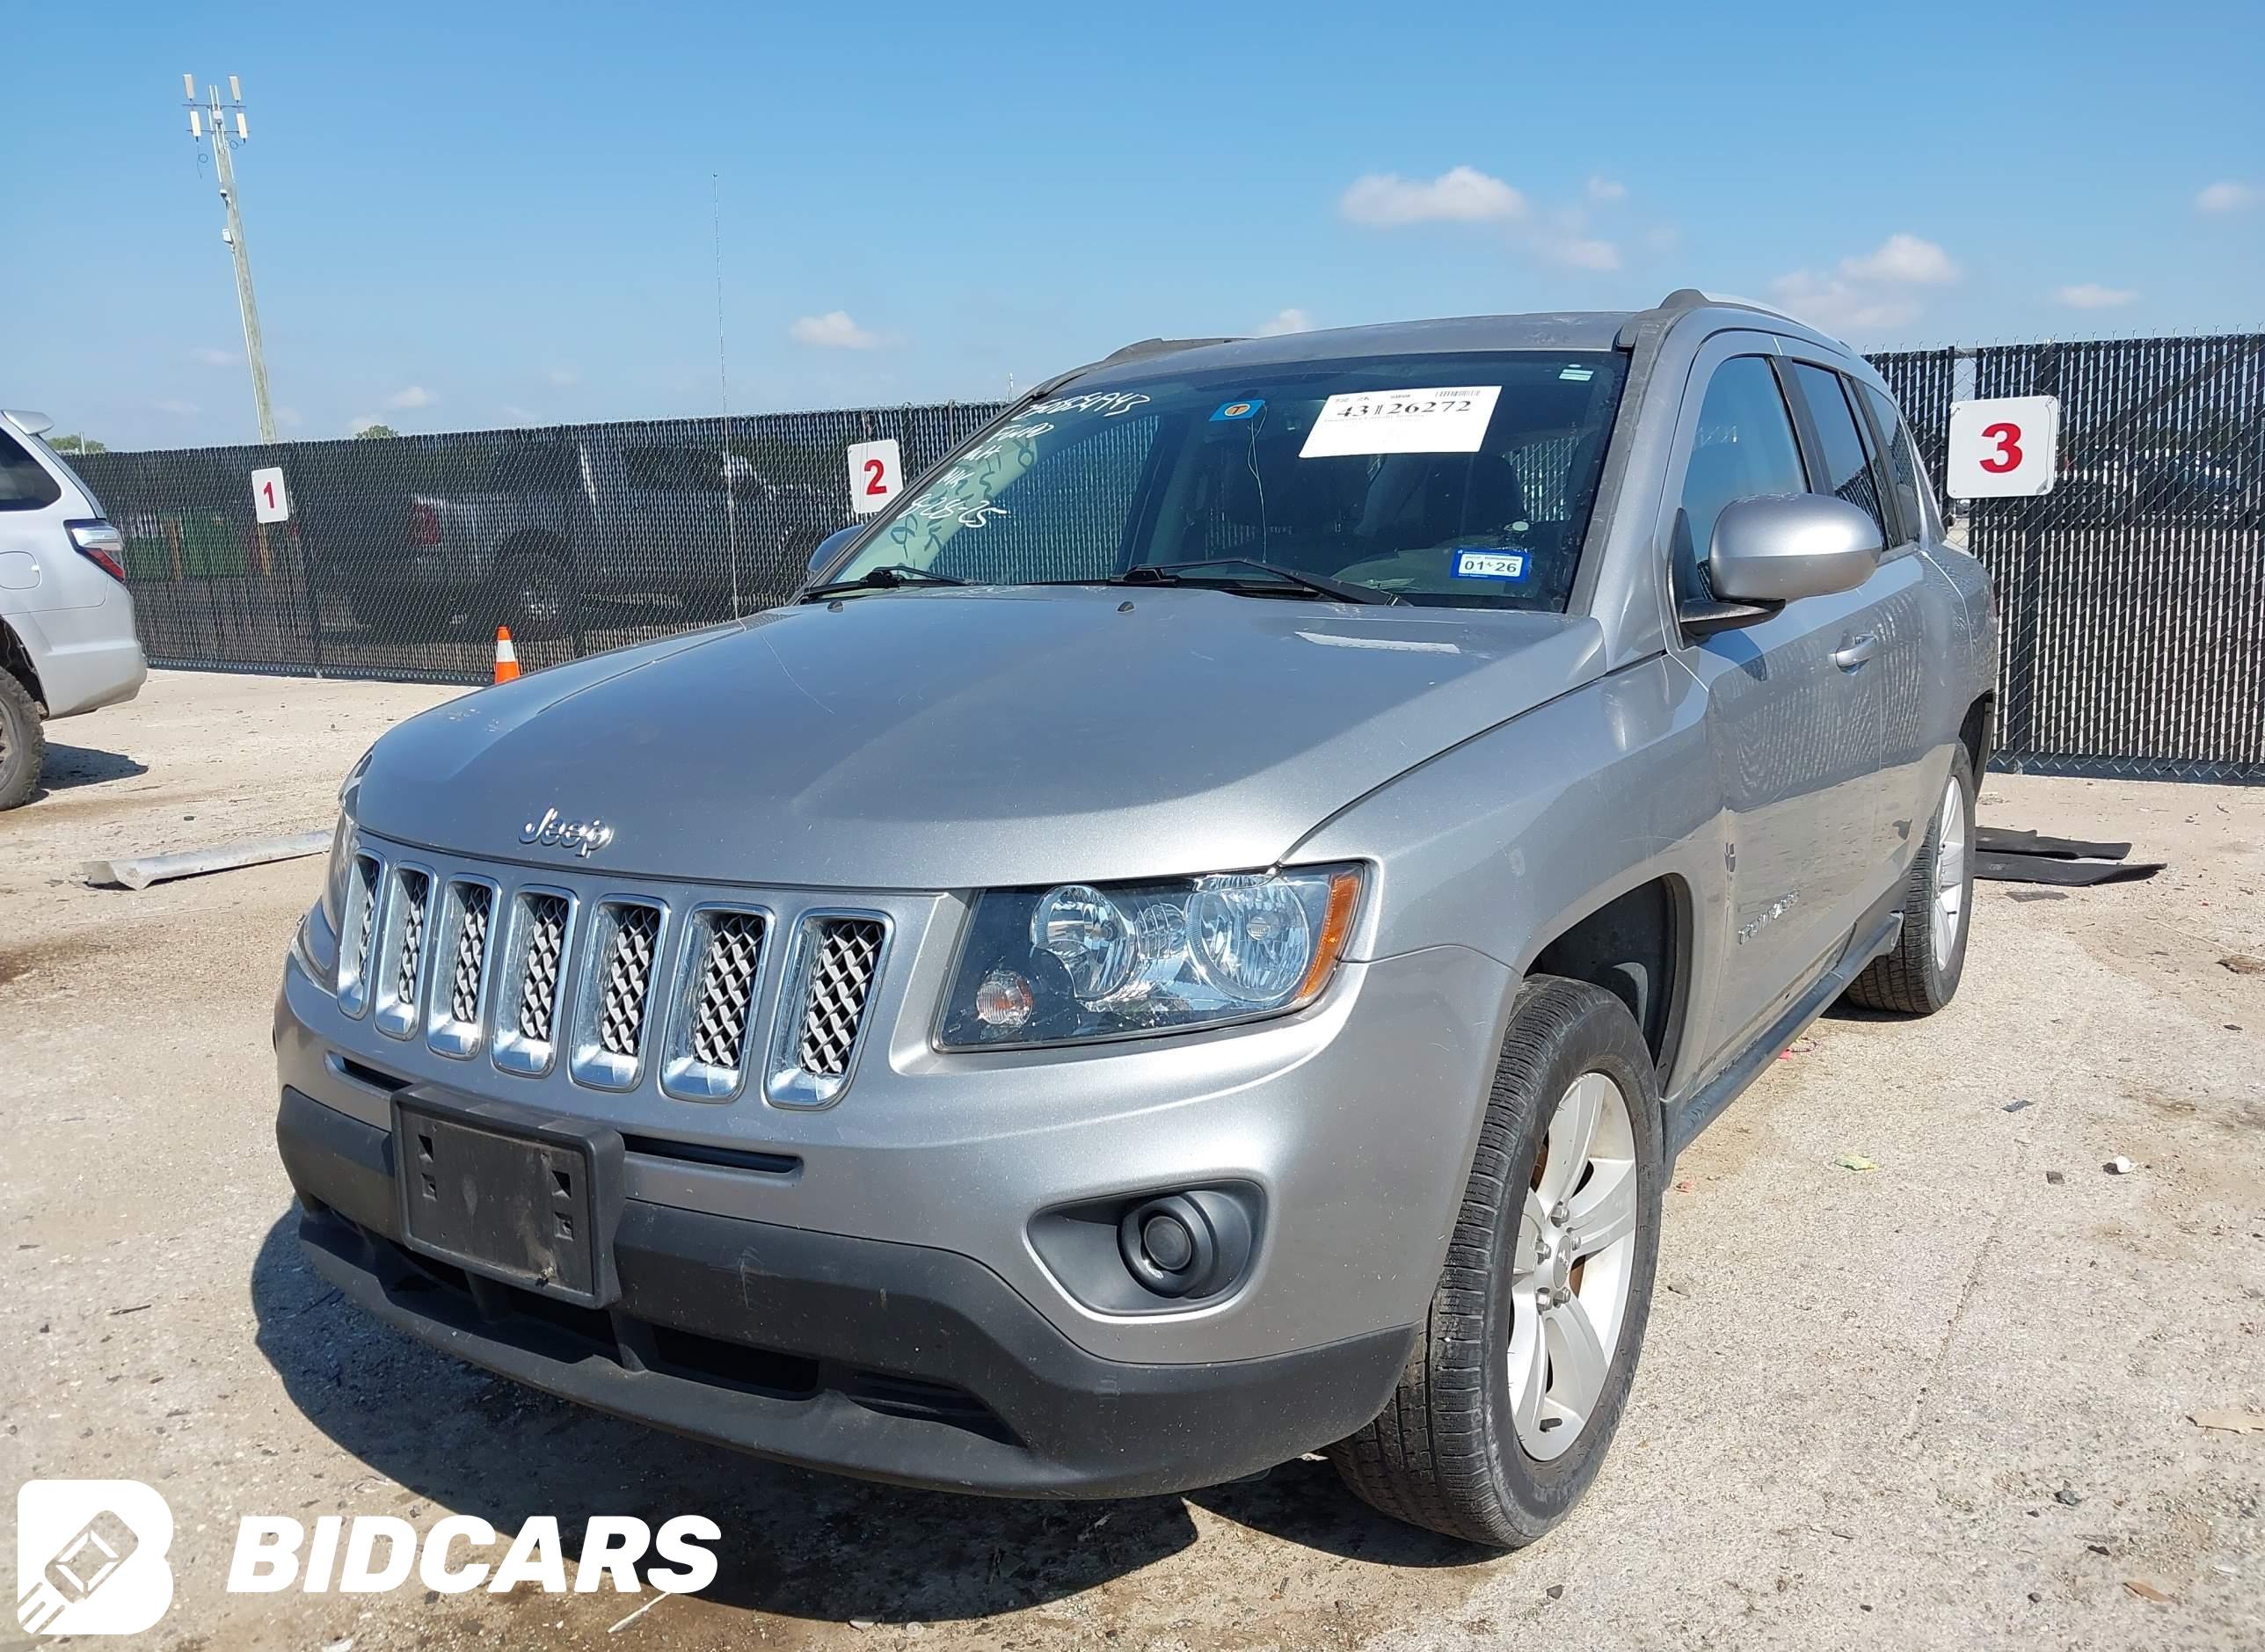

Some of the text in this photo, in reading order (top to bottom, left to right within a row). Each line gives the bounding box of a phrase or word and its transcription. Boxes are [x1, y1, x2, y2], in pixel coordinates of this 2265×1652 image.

[1979, 423, 2023, 473] 3
[263, 481, 275, 509] 1
[863, 459, 888, 496] 2
[1464, 560, 1517, 572] 01 26
[519, 807, 615, 859] Jeep
